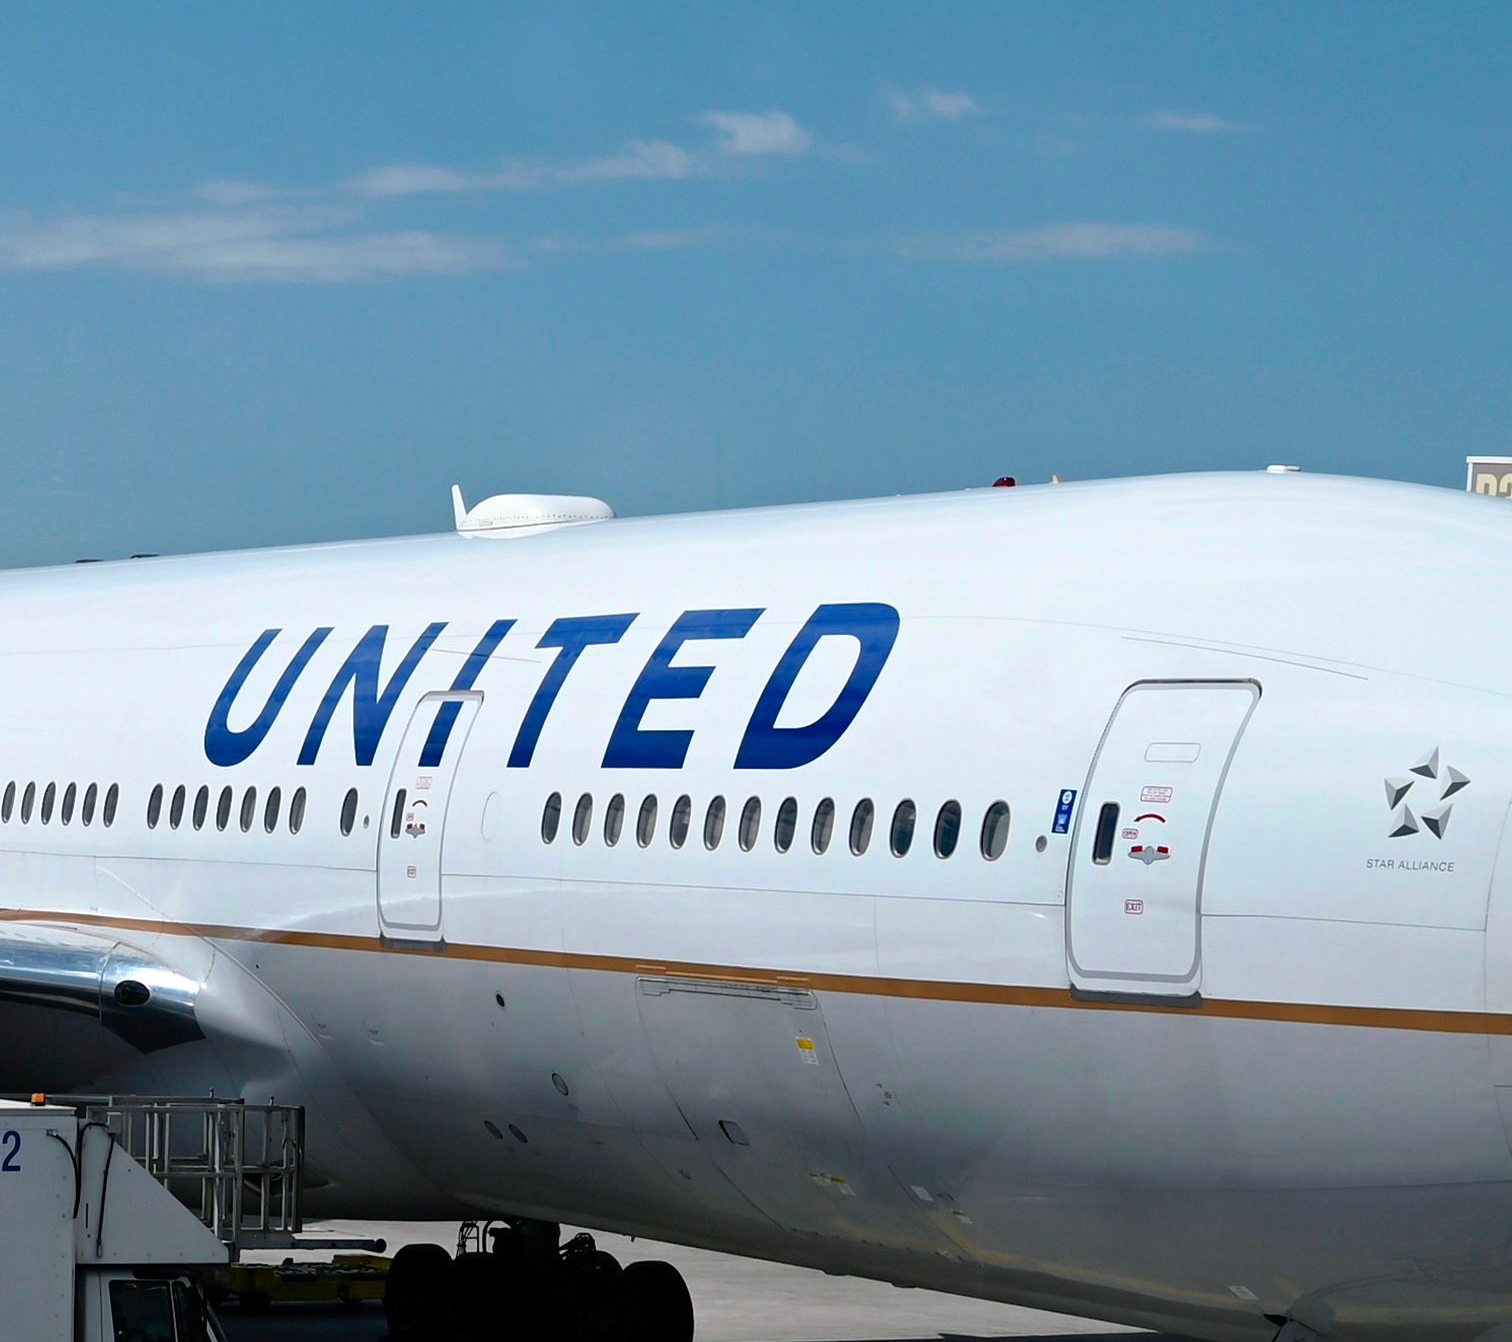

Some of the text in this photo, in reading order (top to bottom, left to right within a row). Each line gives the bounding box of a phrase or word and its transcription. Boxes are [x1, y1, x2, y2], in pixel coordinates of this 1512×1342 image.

[203, 602, 901, 770] UNITED
[1366, 858, 1455, 872] STAR ALLIANCE
